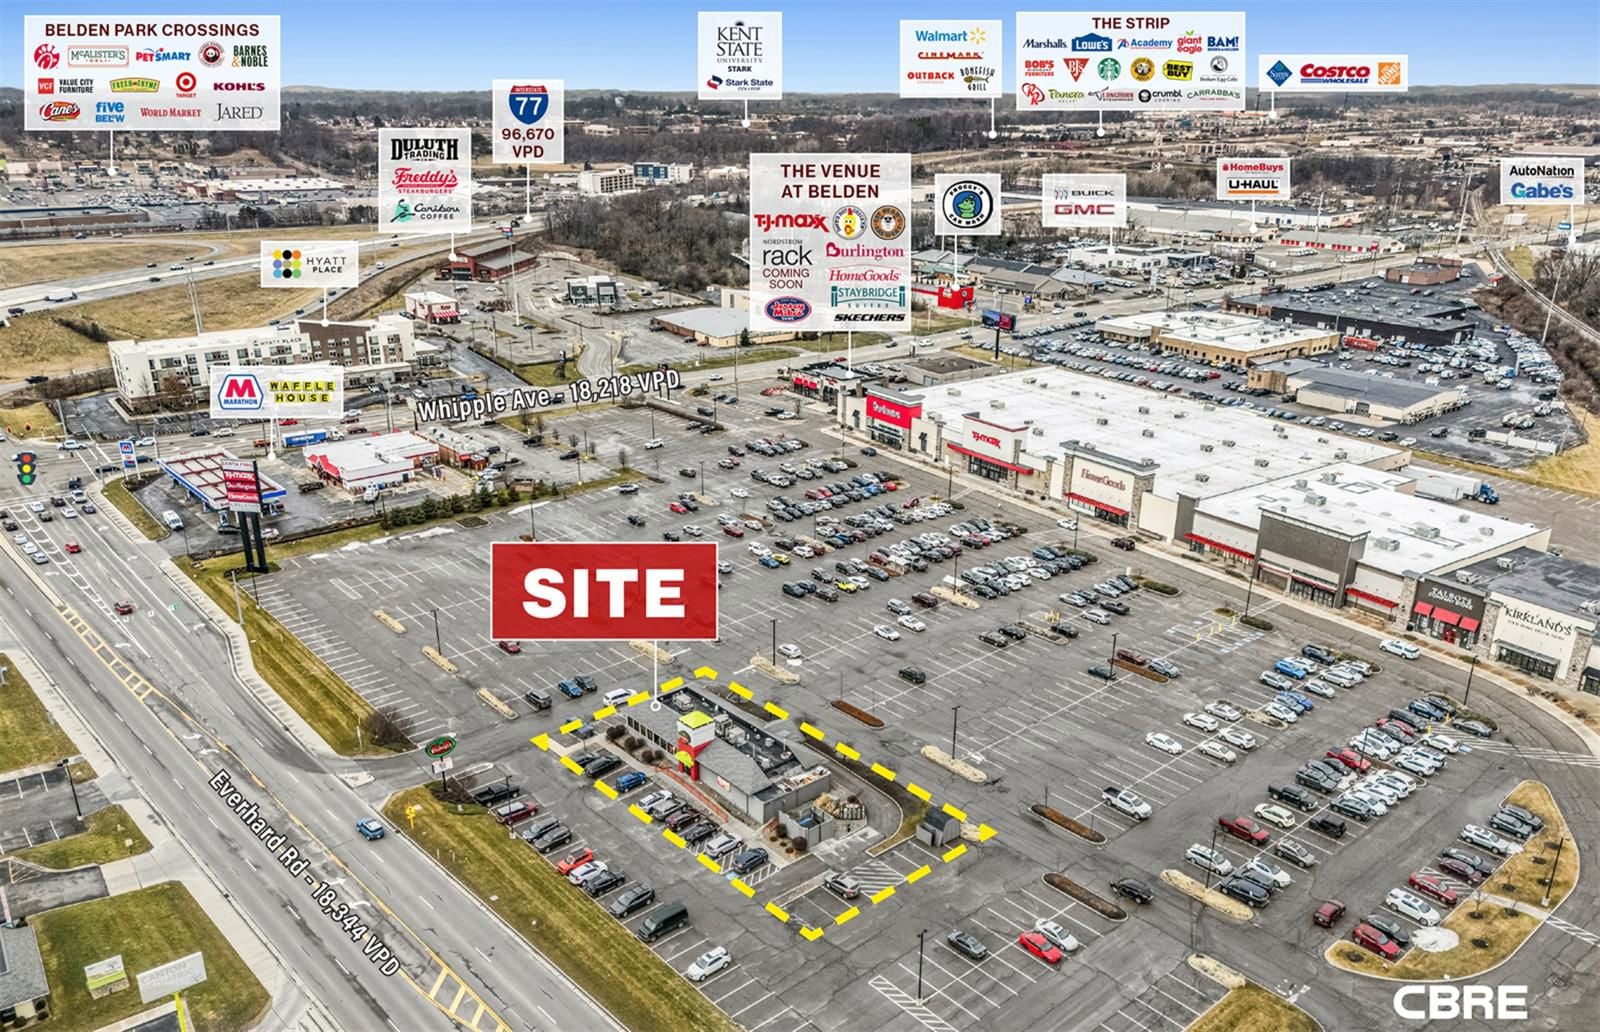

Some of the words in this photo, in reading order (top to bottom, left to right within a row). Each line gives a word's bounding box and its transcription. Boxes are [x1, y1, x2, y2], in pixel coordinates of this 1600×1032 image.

[1081, 468, 1126, 492] HomeGoods
[1431, 587, 1473, 605] TALBOTS
[1503, 605, 1573, 636] KIRKLAND'S
